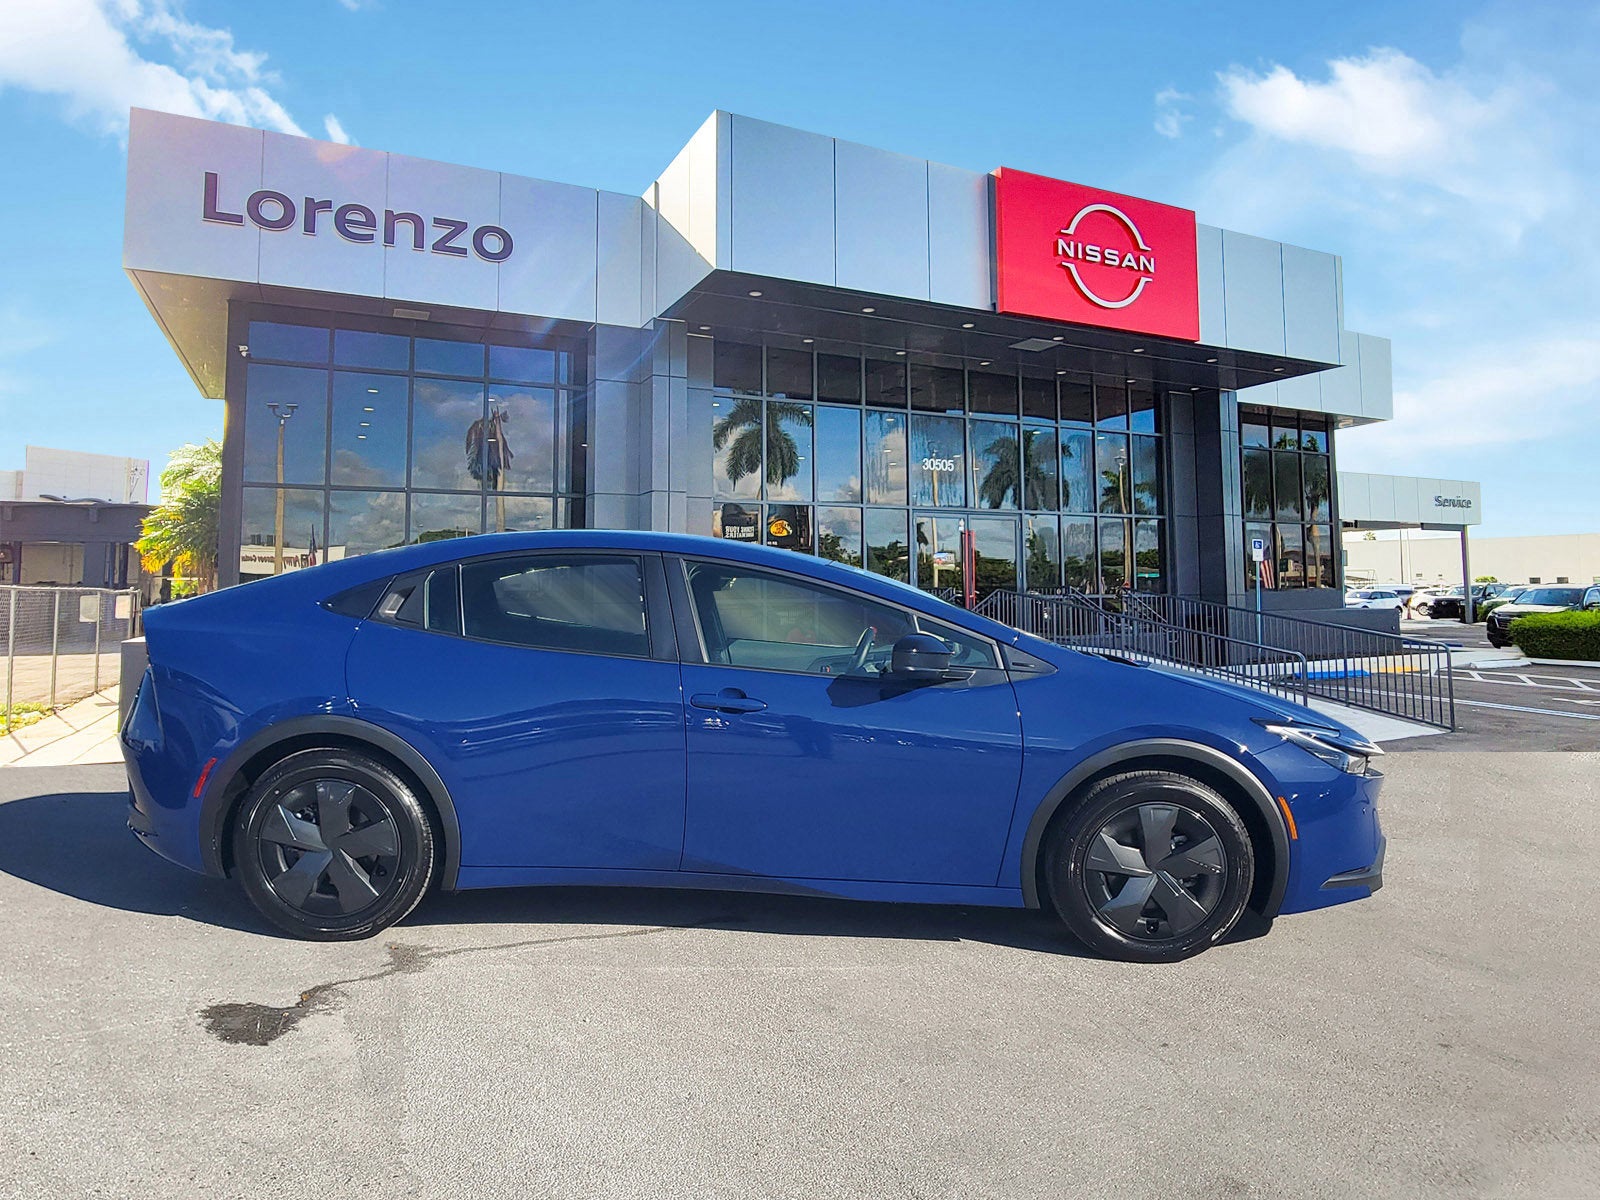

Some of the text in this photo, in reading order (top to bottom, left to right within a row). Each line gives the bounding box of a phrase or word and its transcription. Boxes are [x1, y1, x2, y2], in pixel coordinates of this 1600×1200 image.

[203, 171, 514, 262] Lorenzo
[1058, 238, 1155, 273] NISSAN
[922, 458, 955, 471] 30505
[1434, 495, 1472, 509] Service
